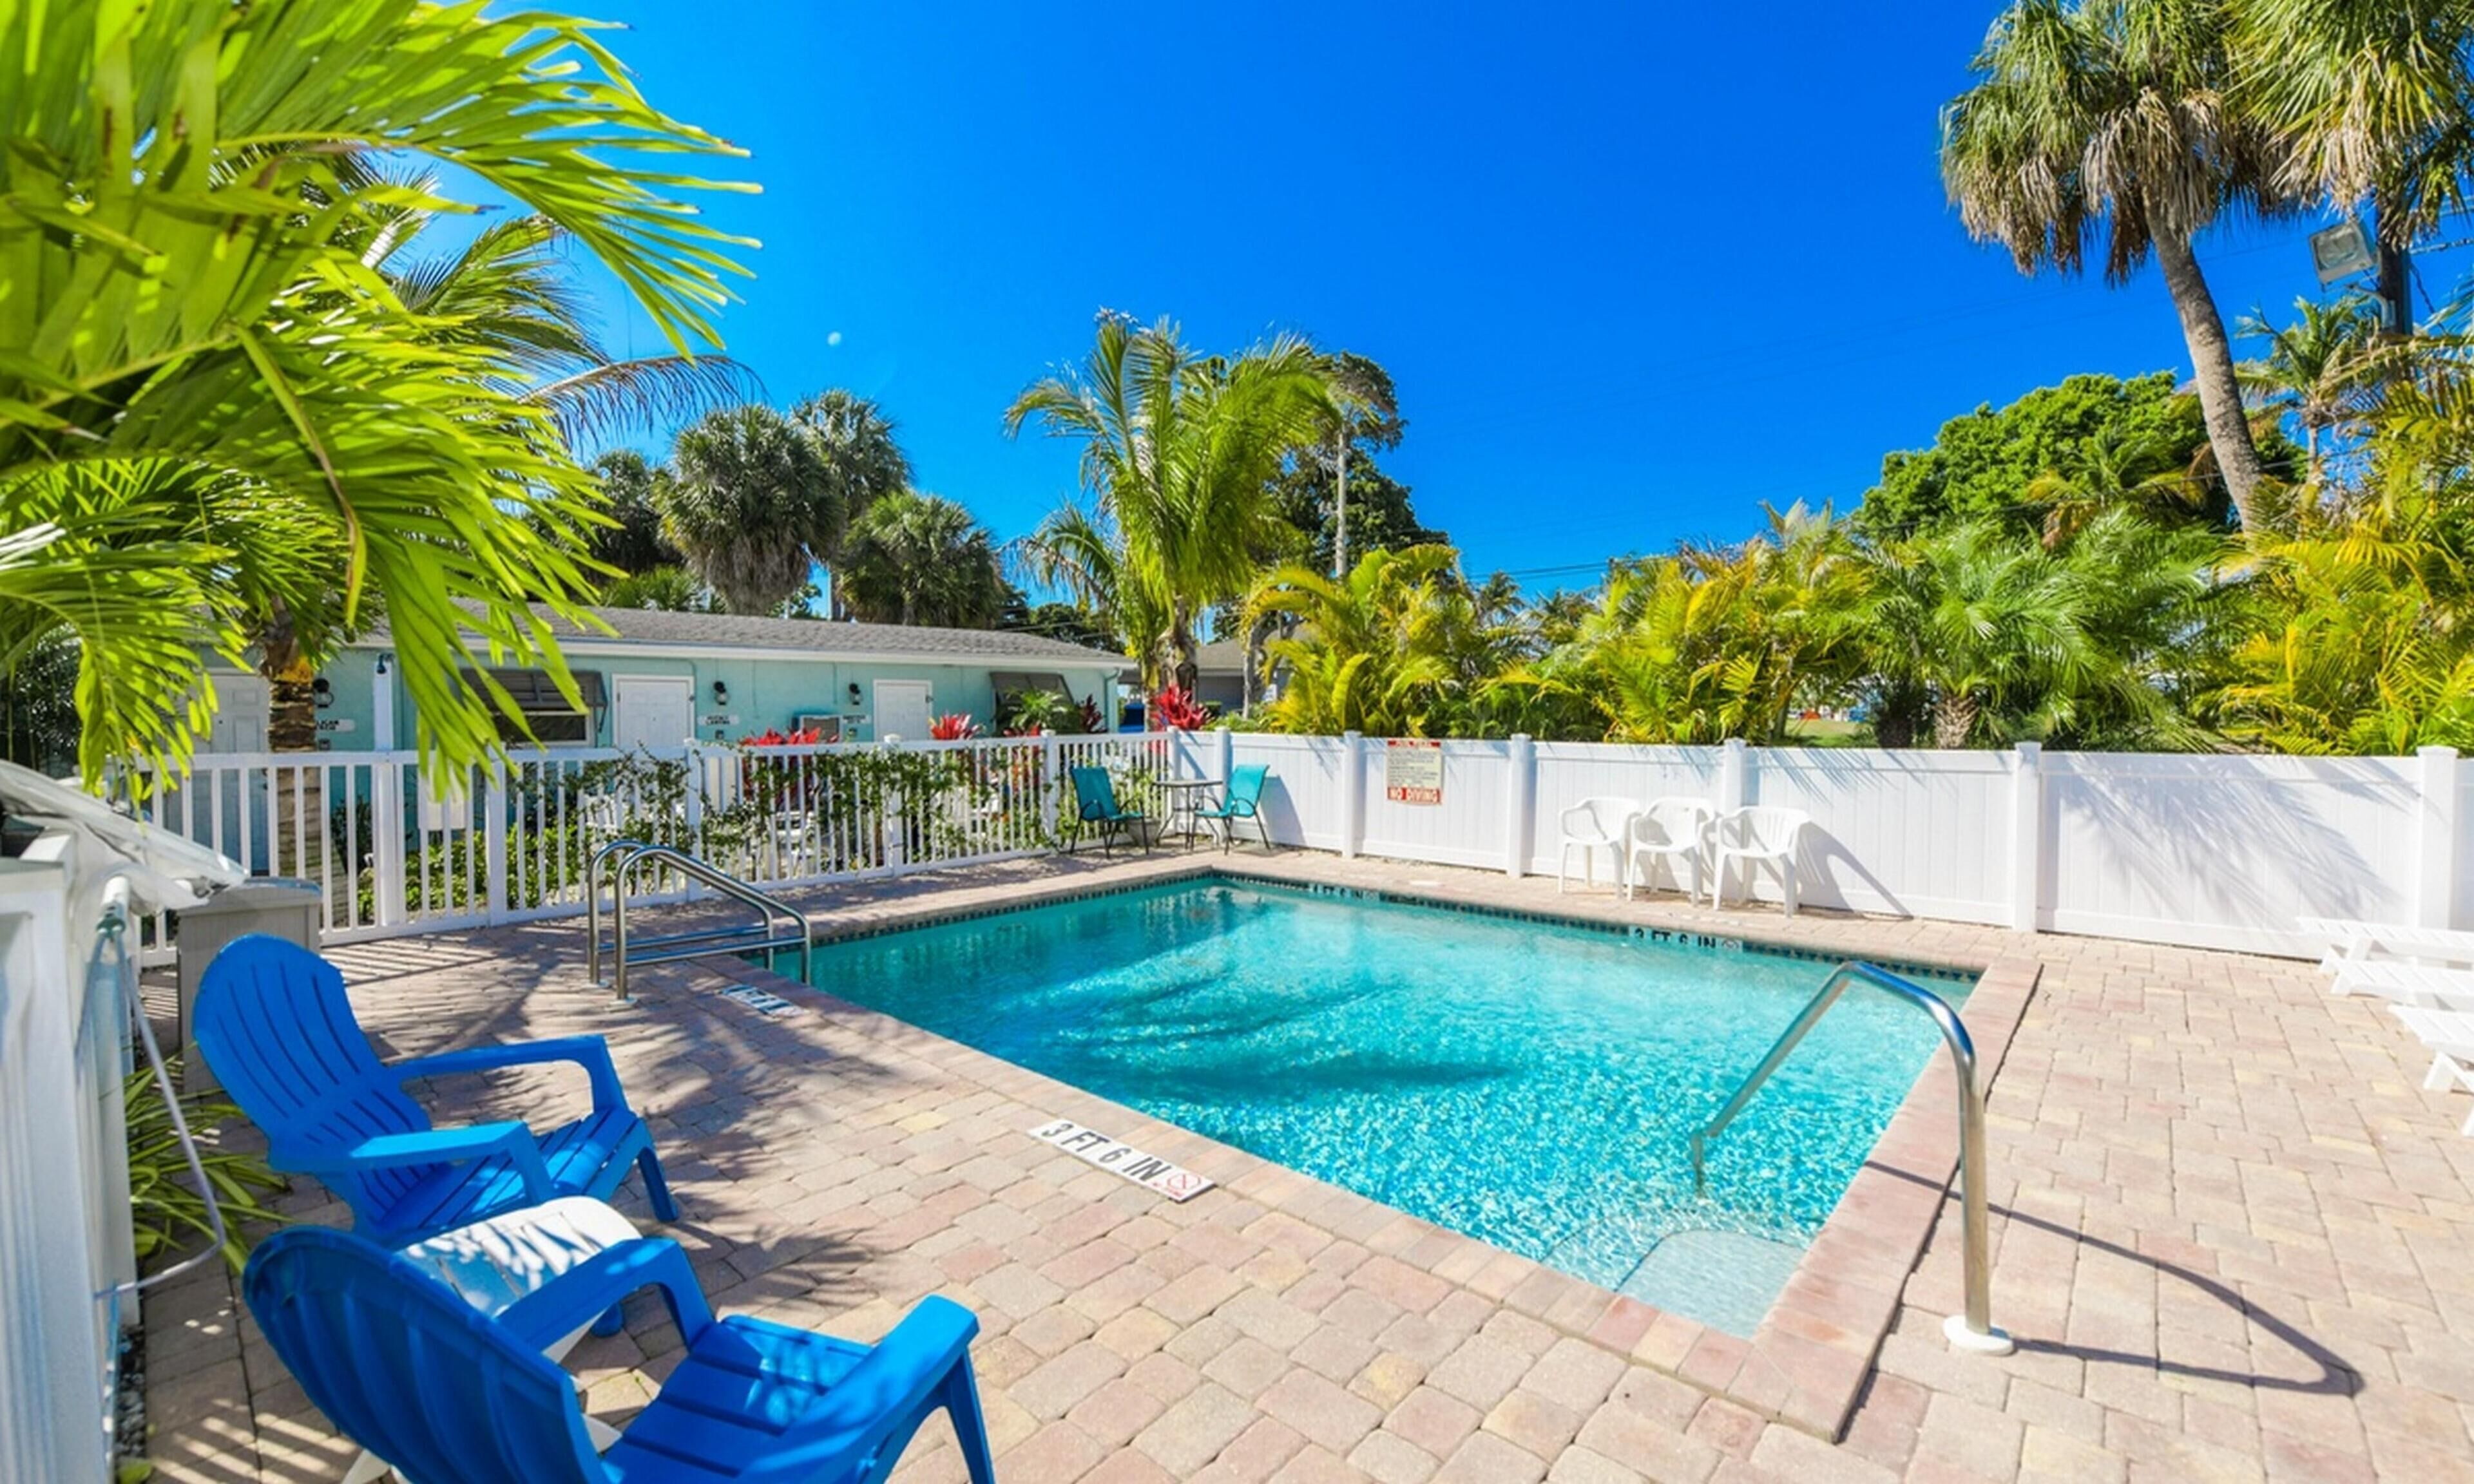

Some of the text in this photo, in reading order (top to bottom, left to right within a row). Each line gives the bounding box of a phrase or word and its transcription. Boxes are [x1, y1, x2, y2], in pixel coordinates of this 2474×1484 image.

[1390, 787, 1437, 803] NO DIVING
[1651, 930, 1671, 942] FT
[1698, 935, 1716, 948] IN
[1042, 1123, 1171, 1181] 3 FT 6 IN
